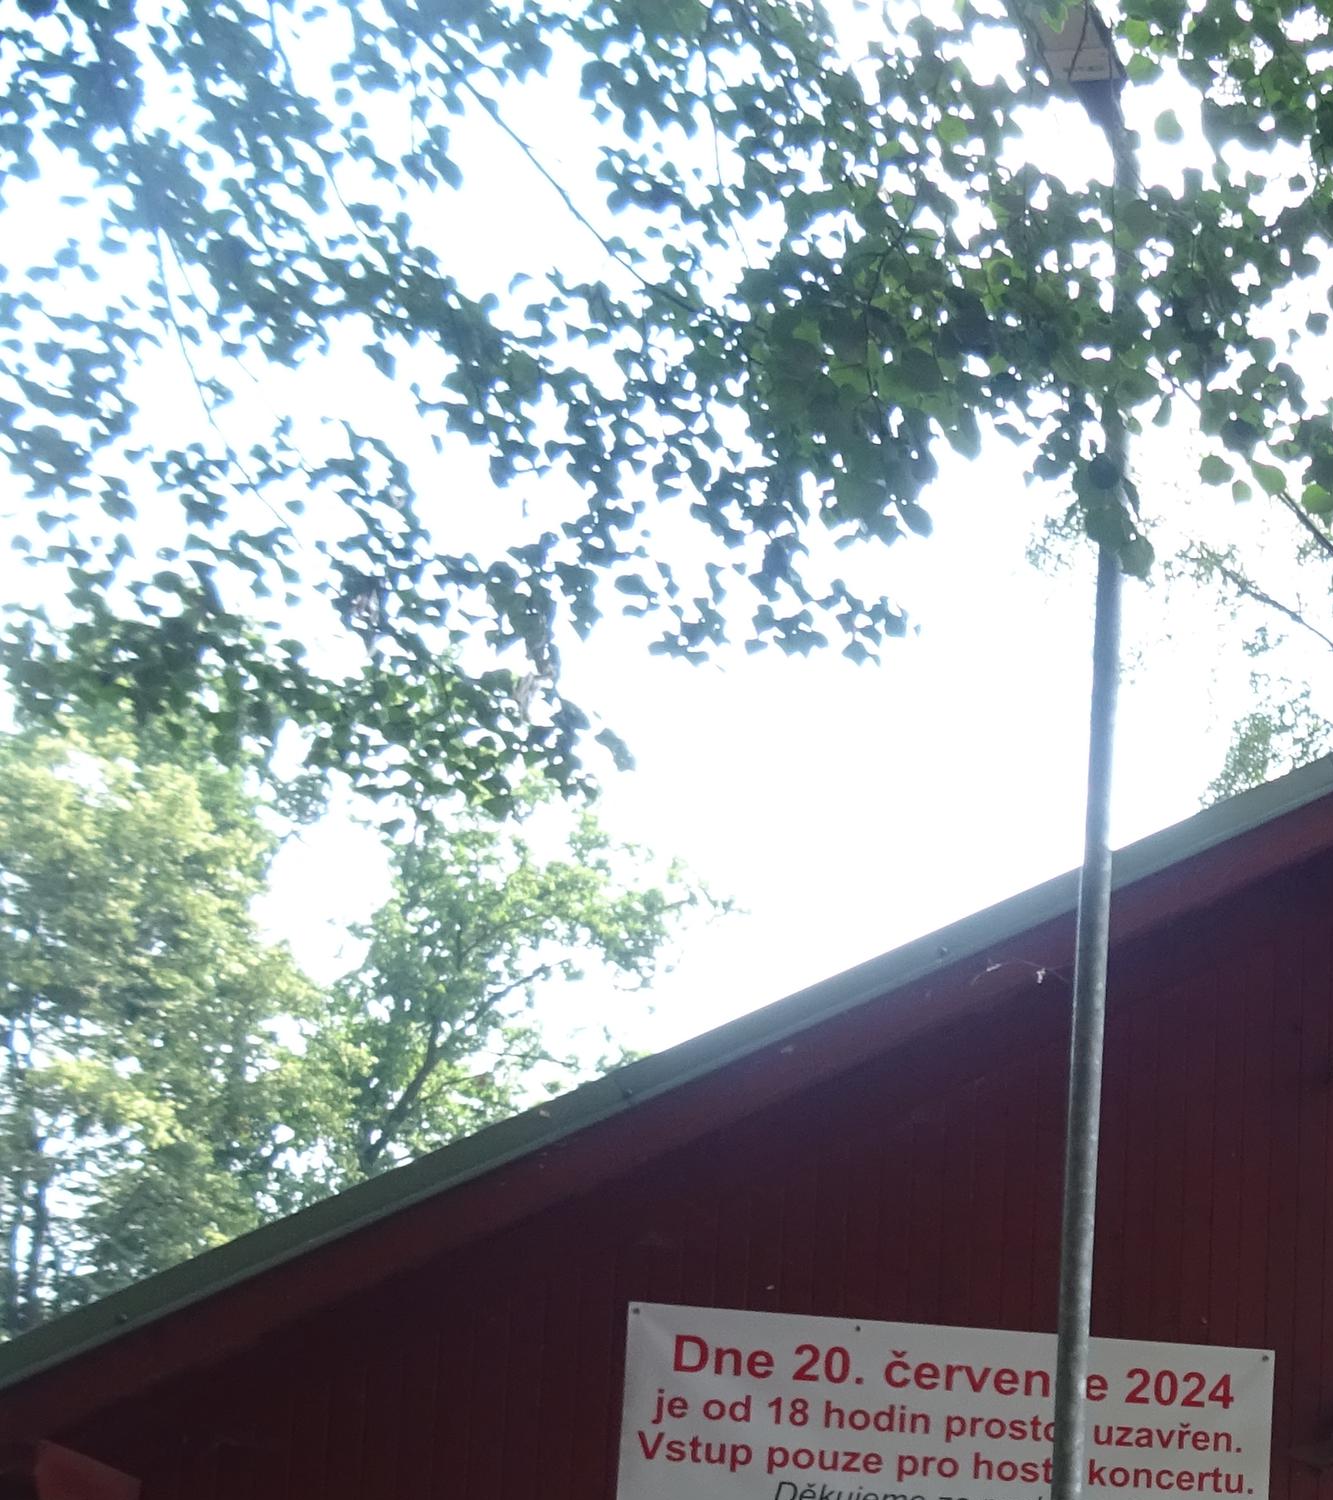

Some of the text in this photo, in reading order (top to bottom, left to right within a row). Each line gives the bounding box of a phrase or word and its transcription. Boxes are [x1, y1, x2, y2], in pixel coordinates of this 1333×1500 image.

[673, 1334, 1235, 1410] Dne 20. červene 2024
[651, 1387, 1243, 1454] je od 18 hodin prosto uzavřen.
[637, 1430, 1254, 1496] Vstup pouze pro host koncertu.
